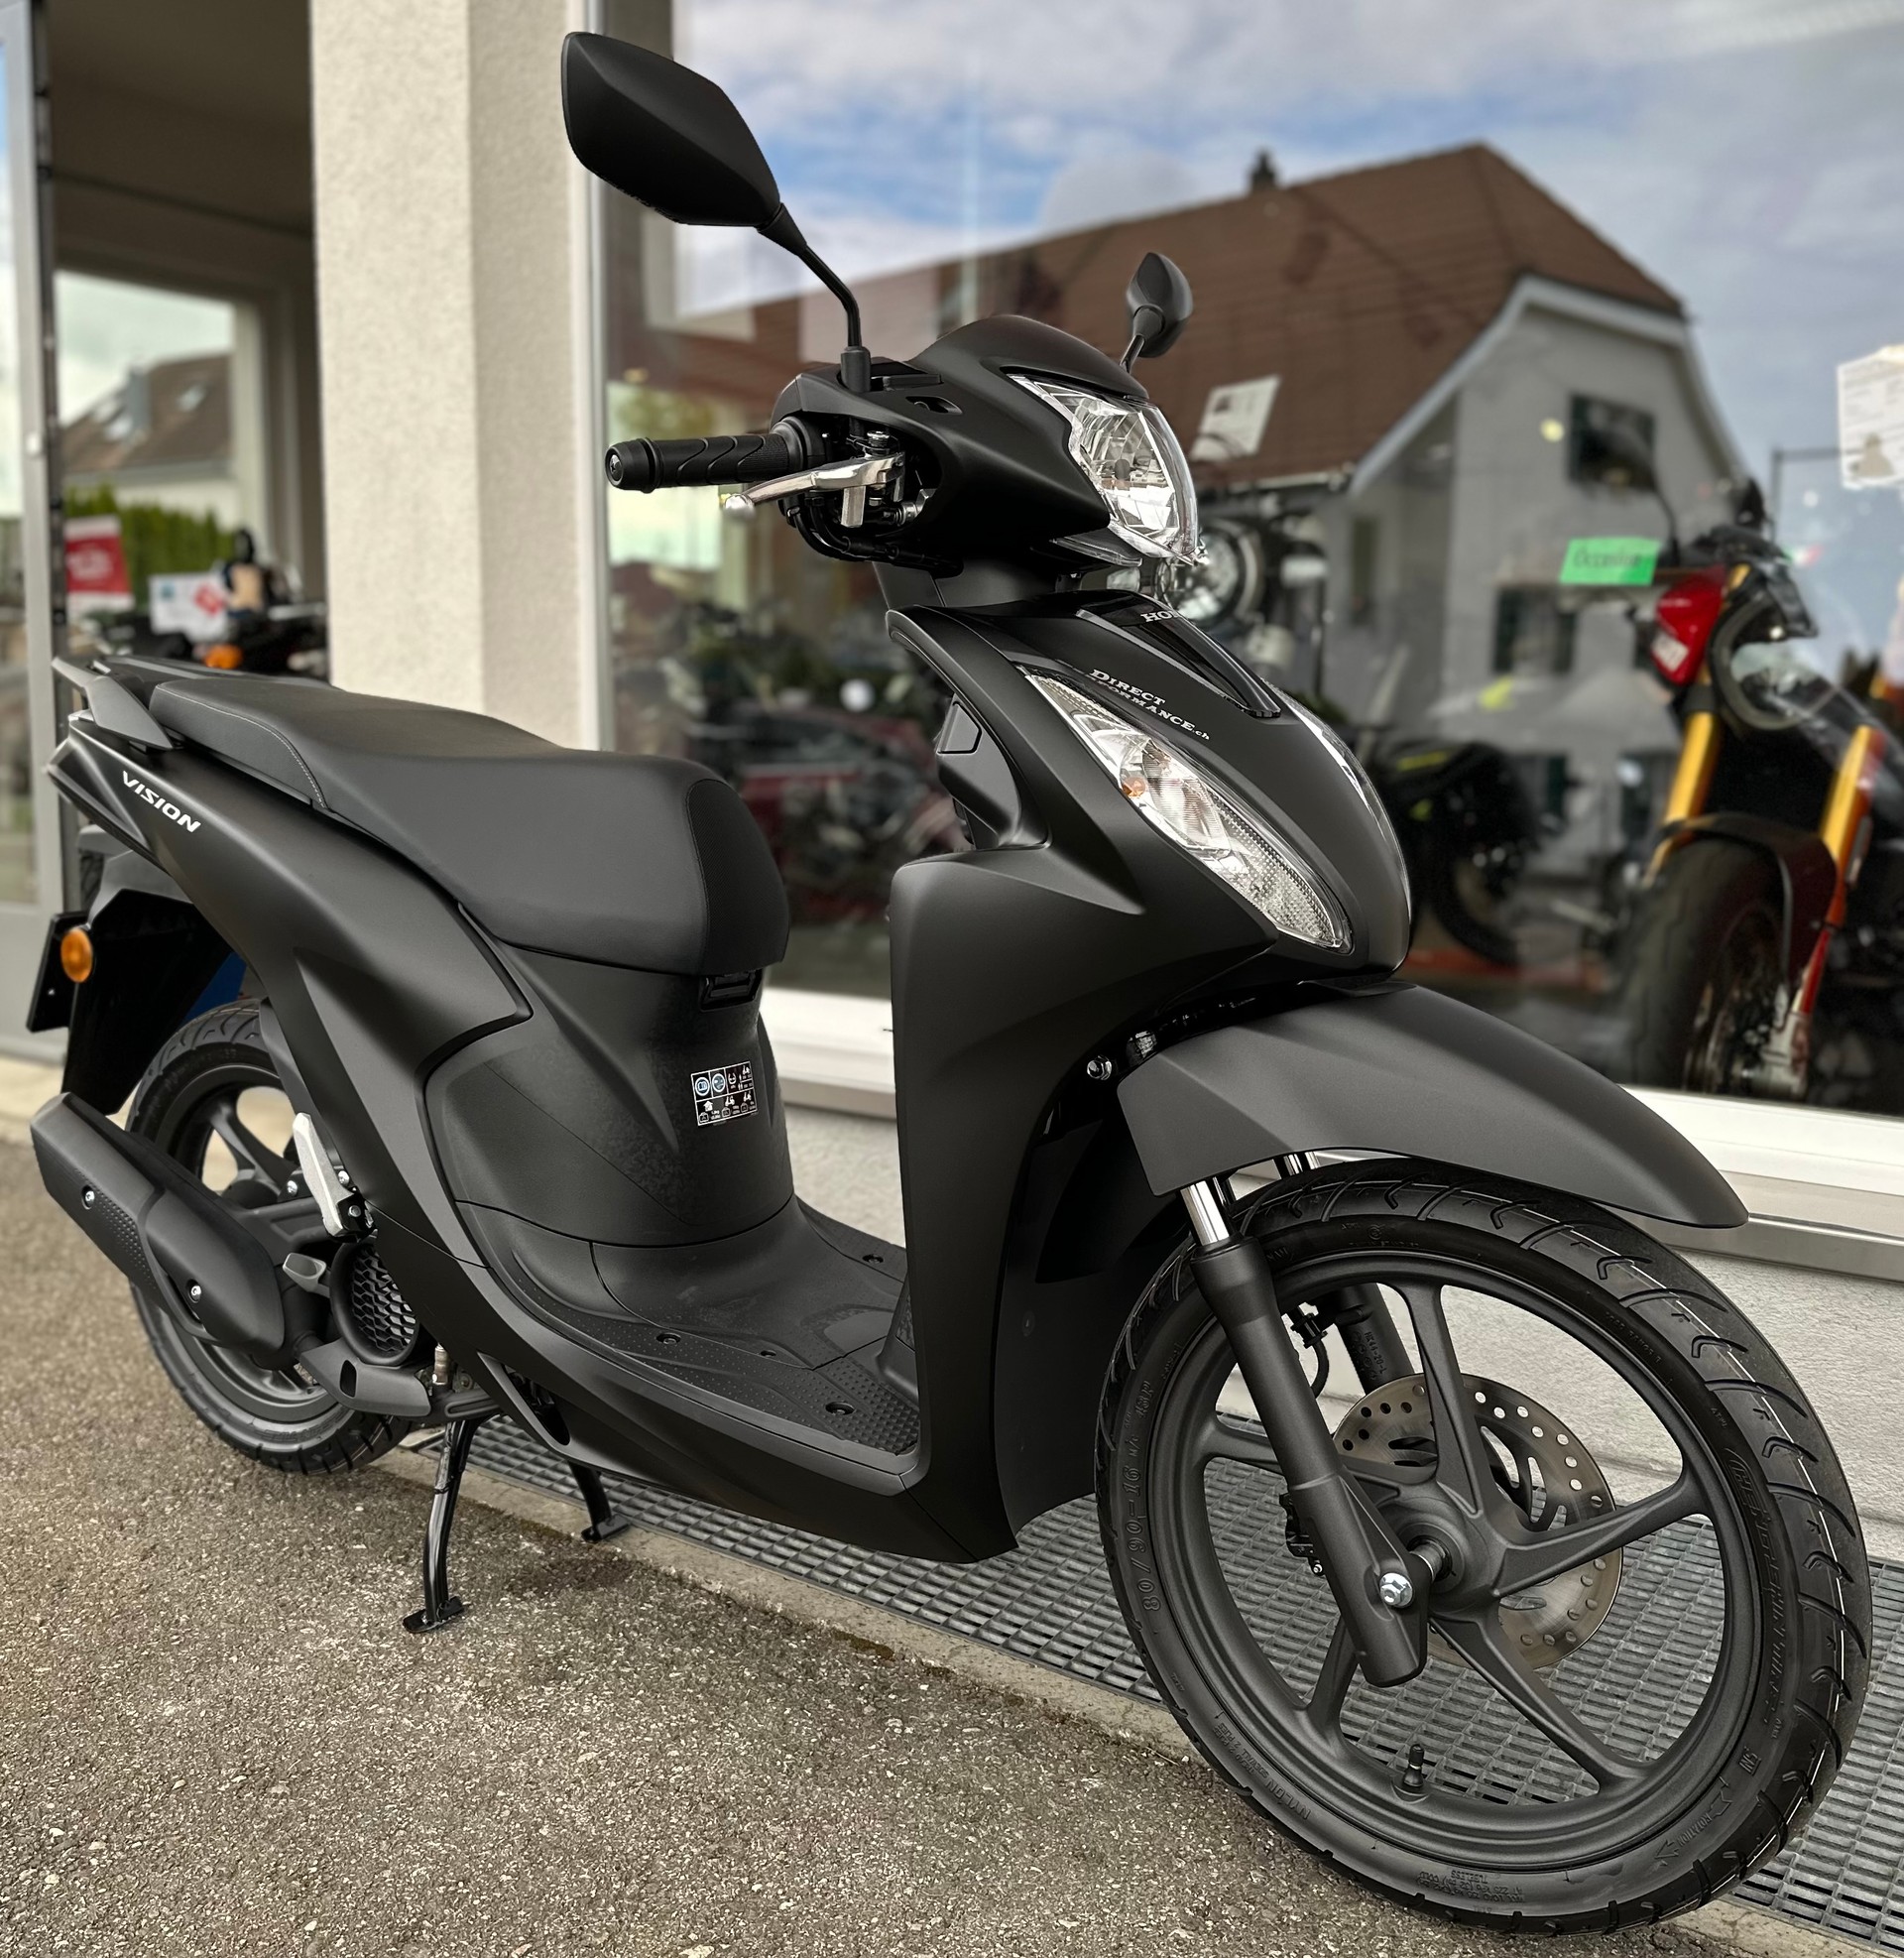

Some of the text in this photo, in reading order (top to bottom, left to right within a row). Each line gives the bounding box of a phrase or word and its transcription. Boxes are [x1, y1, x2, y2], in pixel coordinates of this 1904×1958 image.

[1089, 669, 1166, 706] DIRECT
[122, 770, 201, 833] VISION
[1265, 1777, 1312, 1821] NYLON
